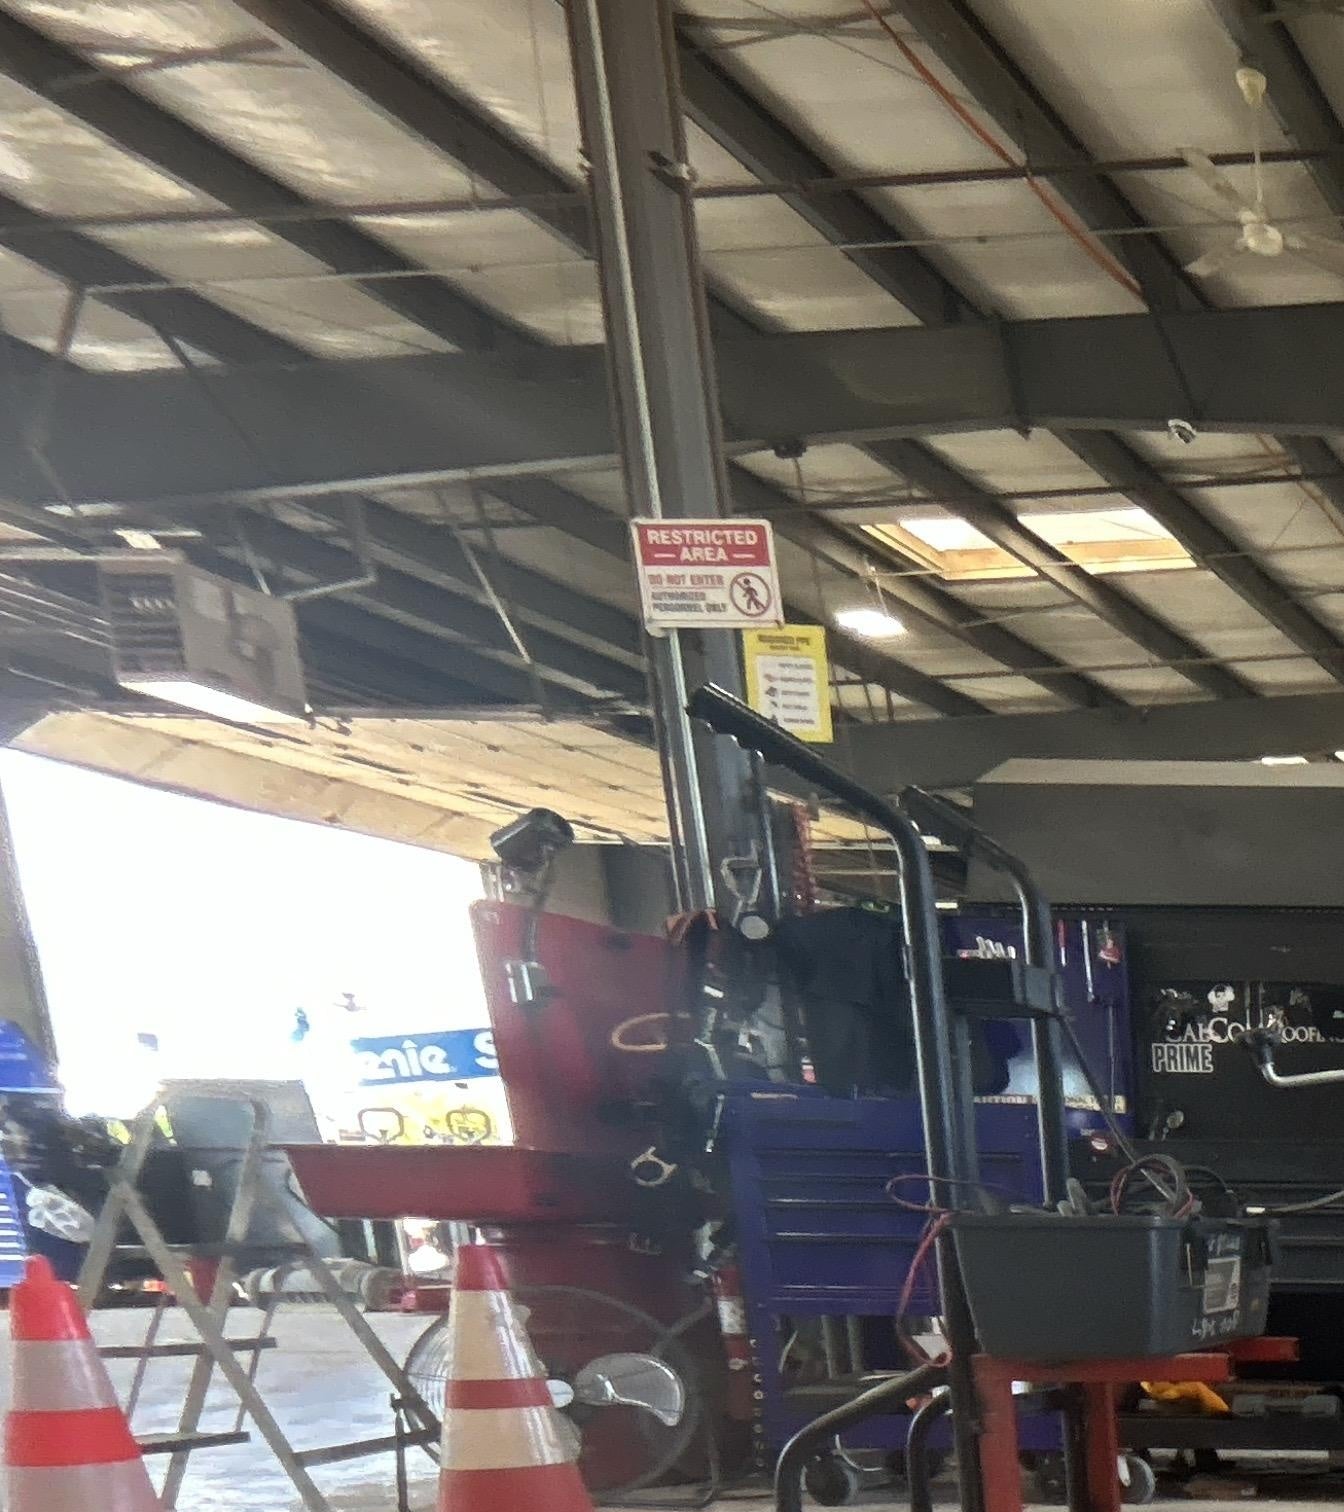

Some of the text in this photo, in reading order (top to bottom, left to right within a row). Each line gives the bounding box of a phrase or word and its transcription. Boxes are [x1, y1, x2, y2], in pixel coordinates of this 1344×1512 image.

[646, 529, 758, 546] RESTRICTED
[679, 546, 729, 561] AREA
[1151, 1043, 1214, 1073] PRIME
